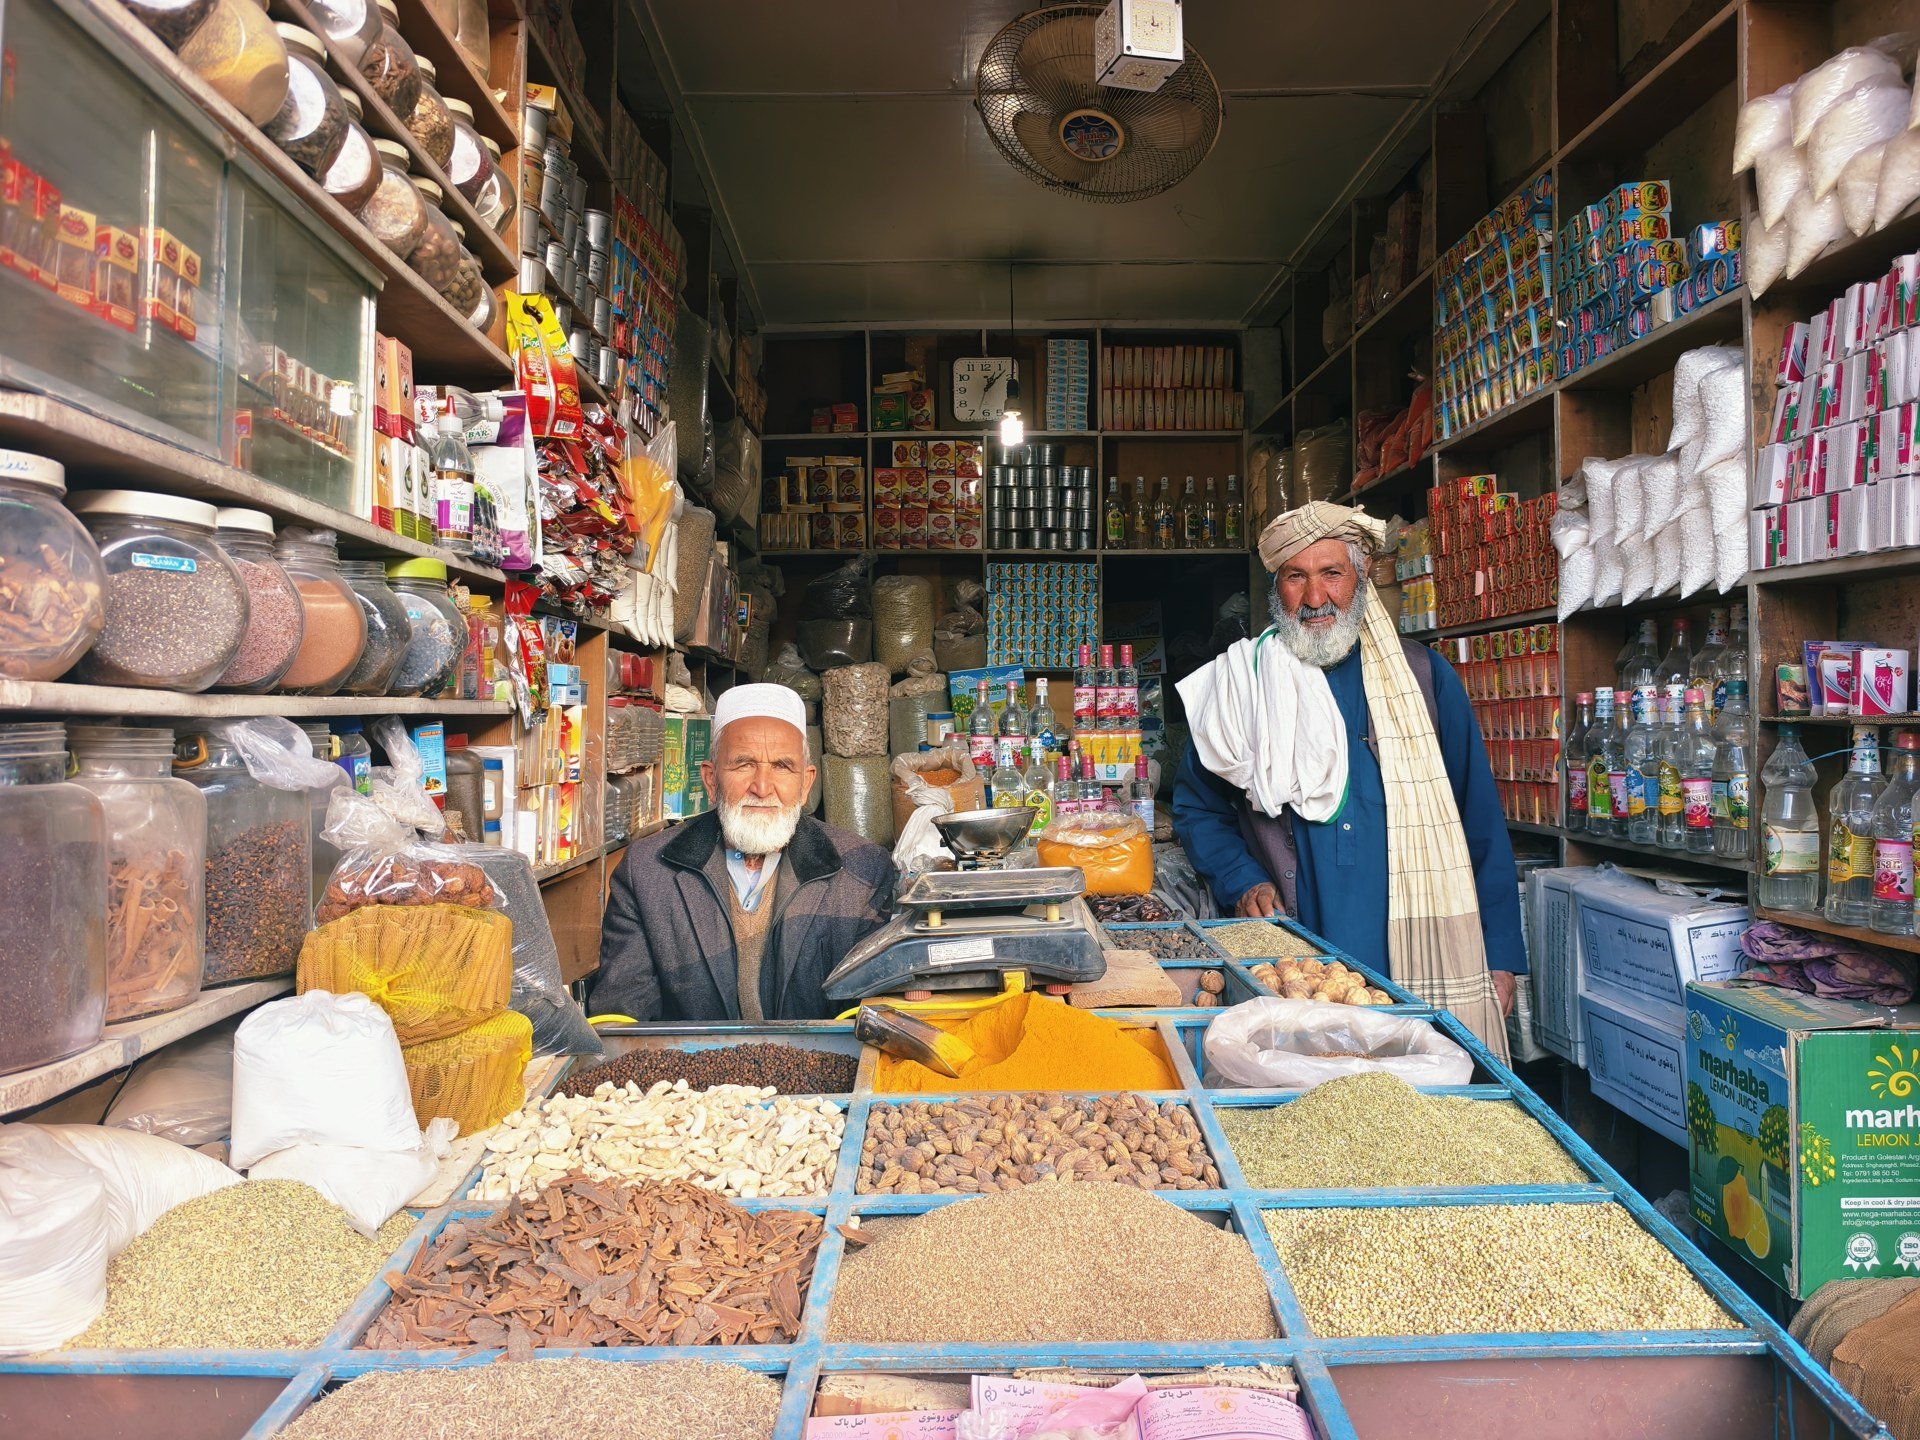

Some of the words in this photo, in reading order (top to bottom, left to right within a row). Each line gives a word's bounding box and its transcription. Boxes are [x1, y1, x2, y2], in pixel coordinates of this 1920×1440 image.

[1632, 188, 1640, 208] SONY
[1633, 219, 1641, 240] SONY
[1714, 226, 1726, 250] SONY
[1658, 263, 1667, 286] SONY
[959, 374, 970, 382] 10
[959, 400, 968, 408] 8
[982, 409, 991, 417] 6
[1699, 1048, 1769, 1105] marhaba
[1709, 1077, 1735, 1100] LEMON
[1736, 1092, 1758, 1116] JUICE
[1857, 1133, 1910, 1147] LEMON
[1894, 1199, 1905, 1207] dry
[850, 1416, 867, 1428] اصل
